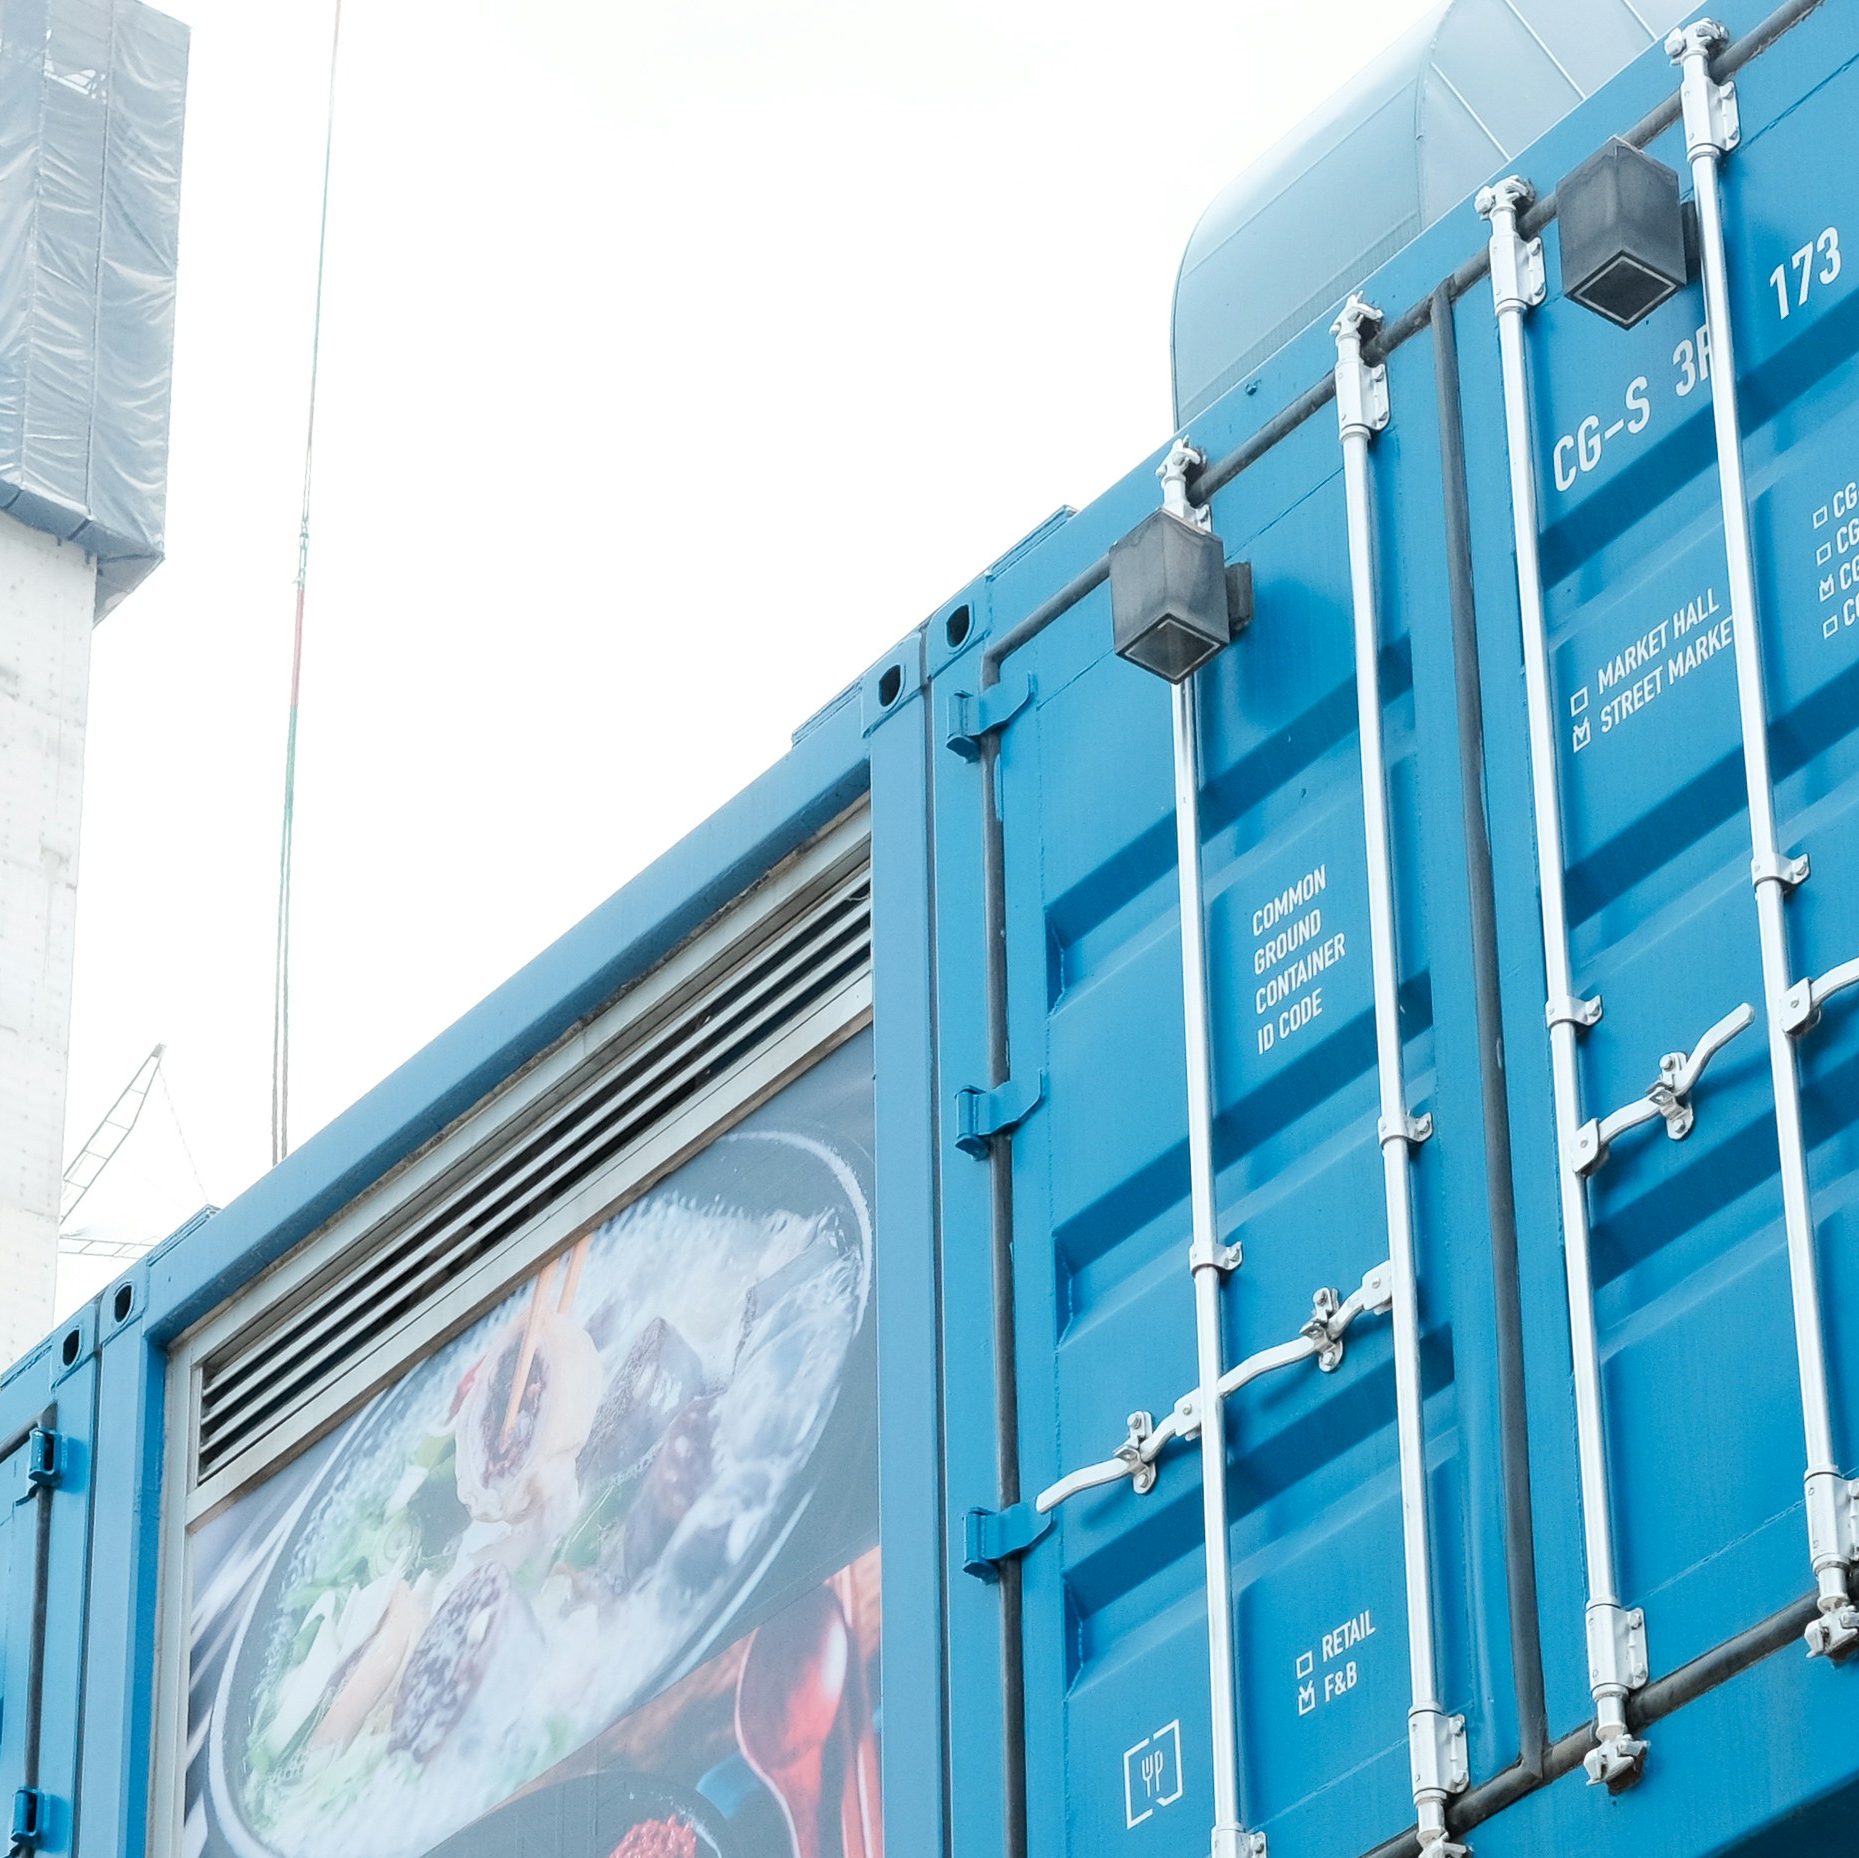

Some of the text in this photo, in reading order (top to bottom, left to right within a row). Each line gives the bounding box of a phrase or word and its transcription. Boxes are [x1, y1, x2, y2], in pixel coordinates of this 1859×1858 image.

[1552, 375, 1651, 492] CG-S
[1768, 226, 1842, 321] 173
[1597, 587, 1720, 695] MARKET HALL
[1599, 614, 1734, 734] STREET MARKE
[1252, 863, 1327, 937] COMMON
[1253, 908, 1322, 976] GROUND
[1255, 932, 1347, 1015] CONTAINER
[1257, 987, 1323, 1056] ID CODE
[1321, 1609, 1377, 1663] RETAIL
[1324, 1660, 1358, 1703] F&B
